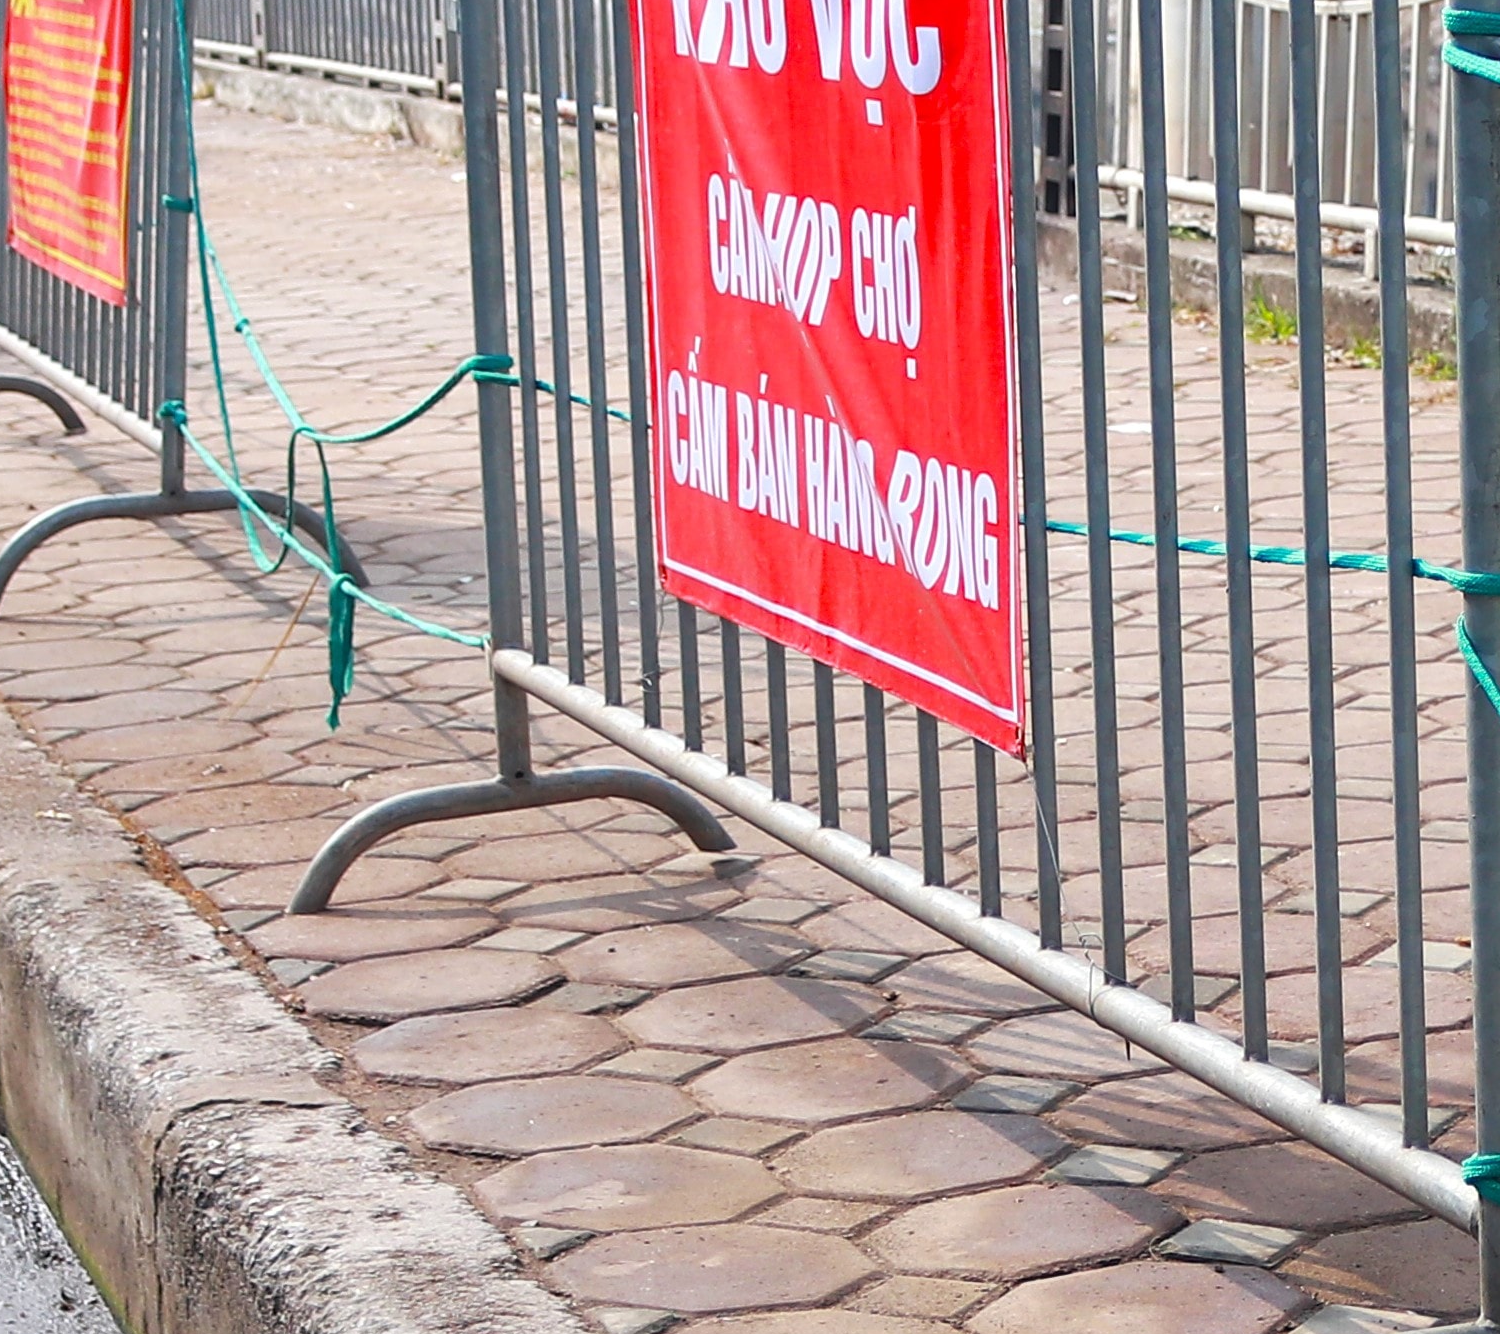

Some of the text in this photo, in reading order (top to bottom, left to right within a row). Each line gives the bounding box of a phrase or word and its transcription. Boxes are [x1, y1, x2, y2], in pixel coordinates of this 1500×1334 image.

[851, 204, 923, 381] CHỢ
[667, 336, 1001, 612] CẤM BÁN HÀNG RONG
